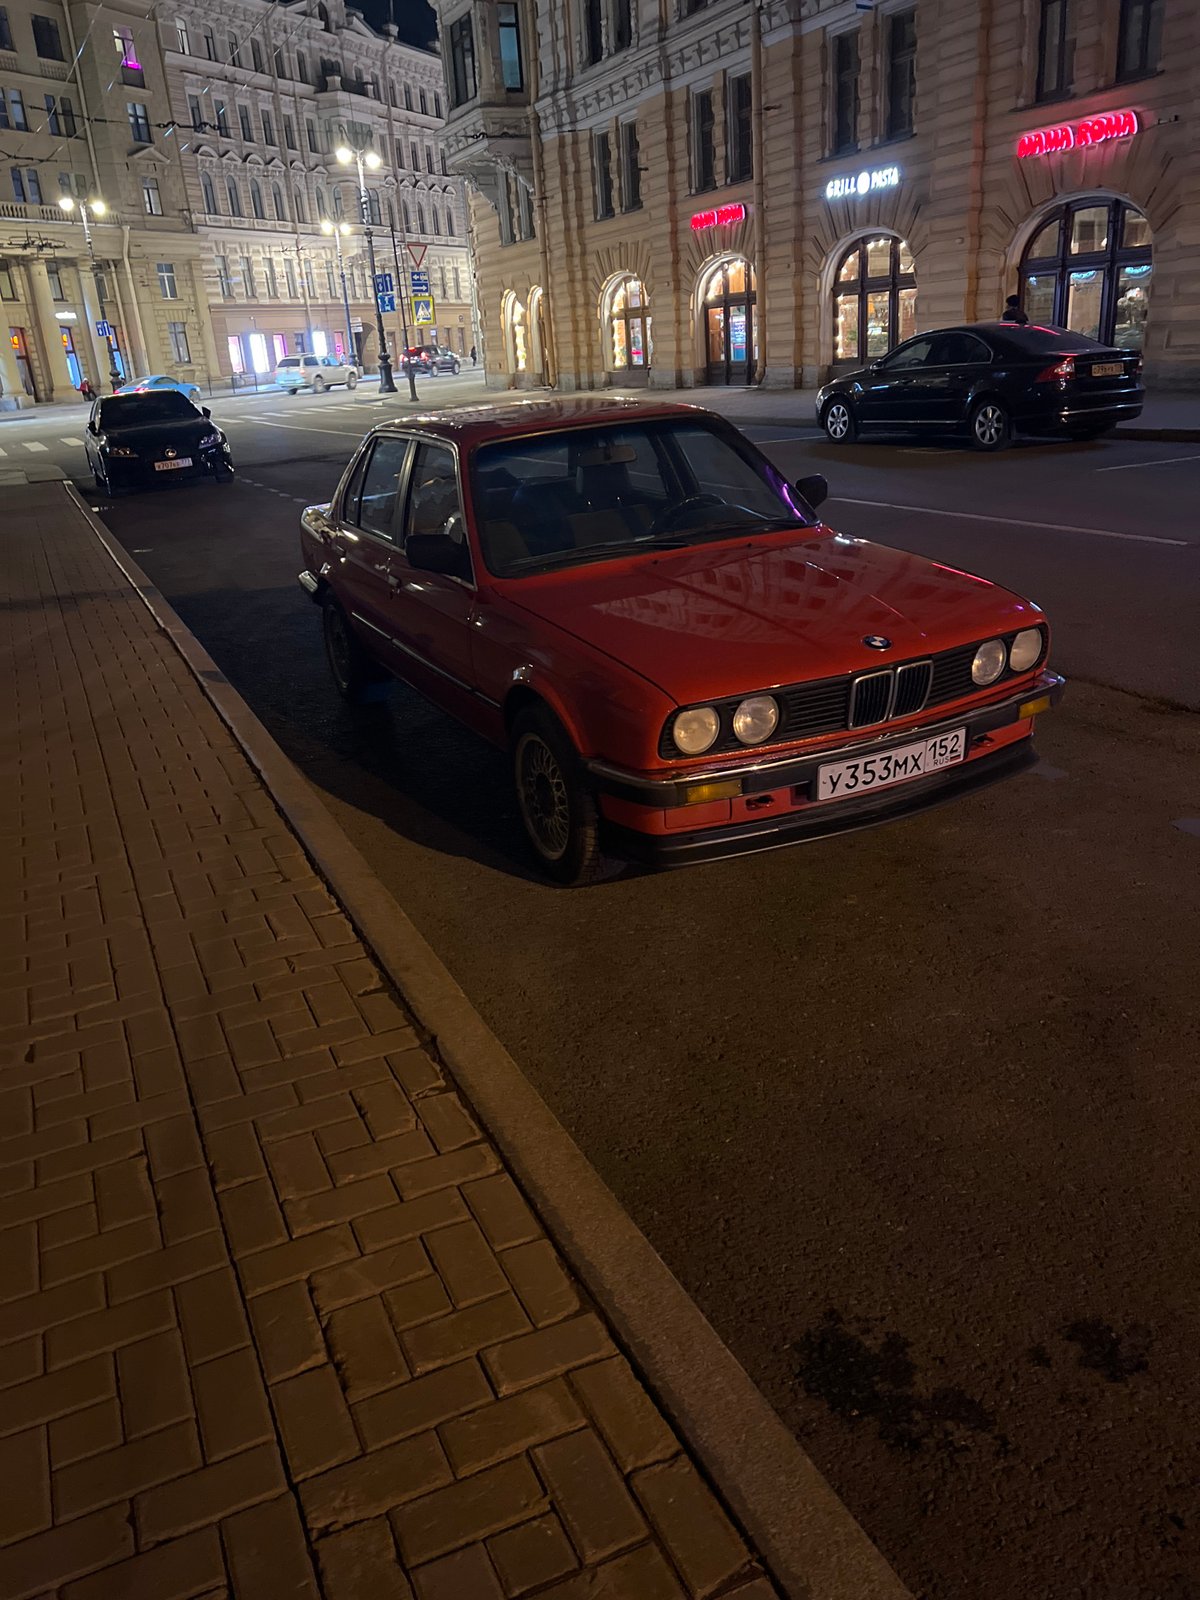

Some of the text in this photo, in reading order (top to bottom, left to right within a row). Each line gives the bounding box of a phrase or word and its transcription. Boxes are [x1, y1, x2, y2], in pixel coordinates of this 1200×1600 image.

[1077, 111, 1138, 146] ROMA
[826, 167, 899, 198] GRILL PASTA
[928, 734, 960, 760] 152
[933, 756, 950, 767] RUS
